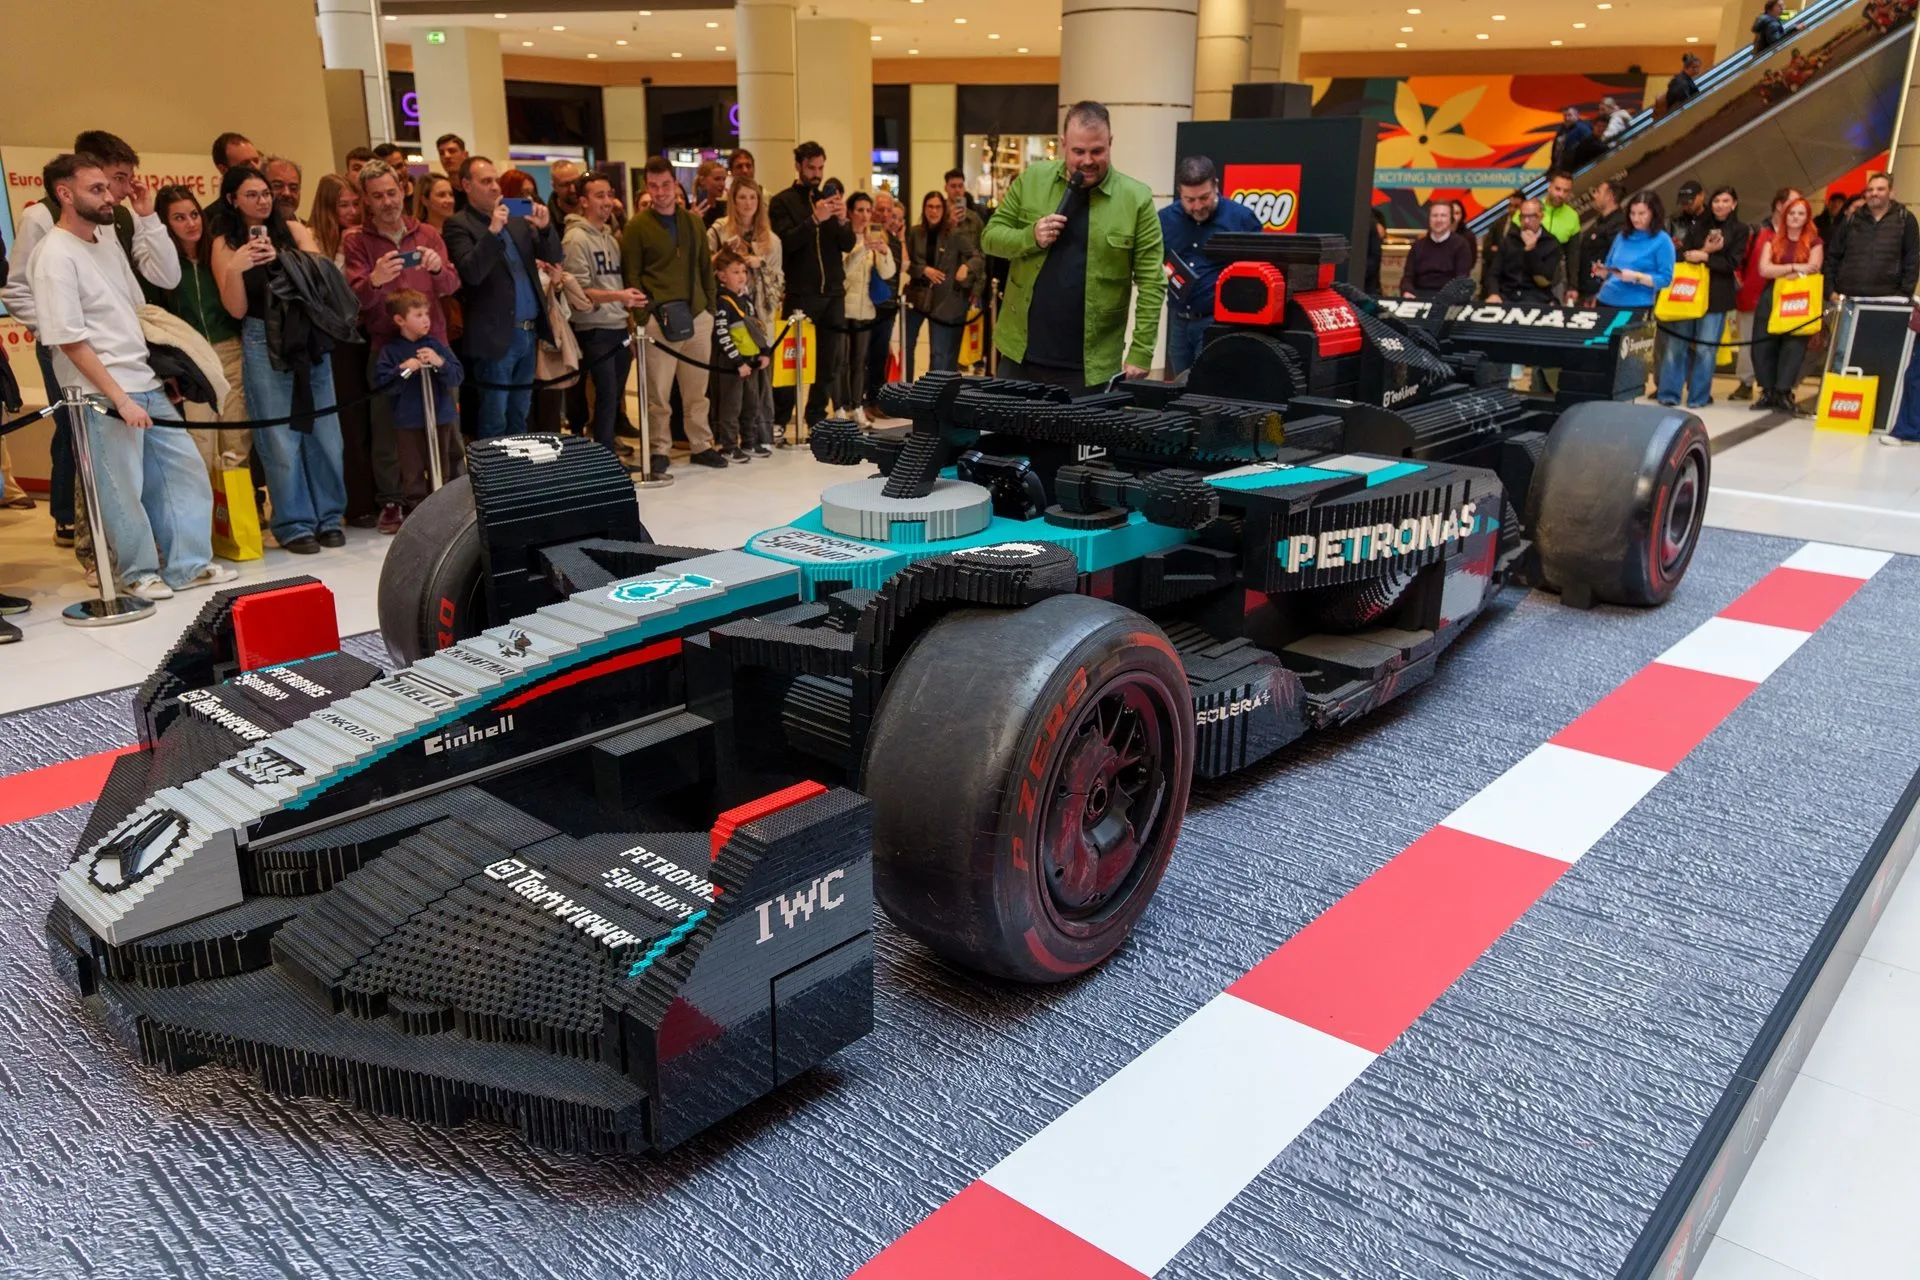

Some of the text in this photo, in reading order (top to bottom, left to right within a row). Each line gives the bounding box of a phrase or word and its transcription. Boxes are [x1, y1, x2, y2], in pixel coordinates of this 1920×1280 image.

[1427, 173, 1462, 185] NEWS
[1464, 173, 1517, 186] COMING
[786, 531, 879, 555] PETRONAS
[1286, 502, 1477, 574] PETRONAS
[1196, 695, 1262, 726] SOLERA
[423, 714, 514, 756] Einhell
[1017, 664, 1089, 825] ZERO
[754, 868, 845, 945] IWC
